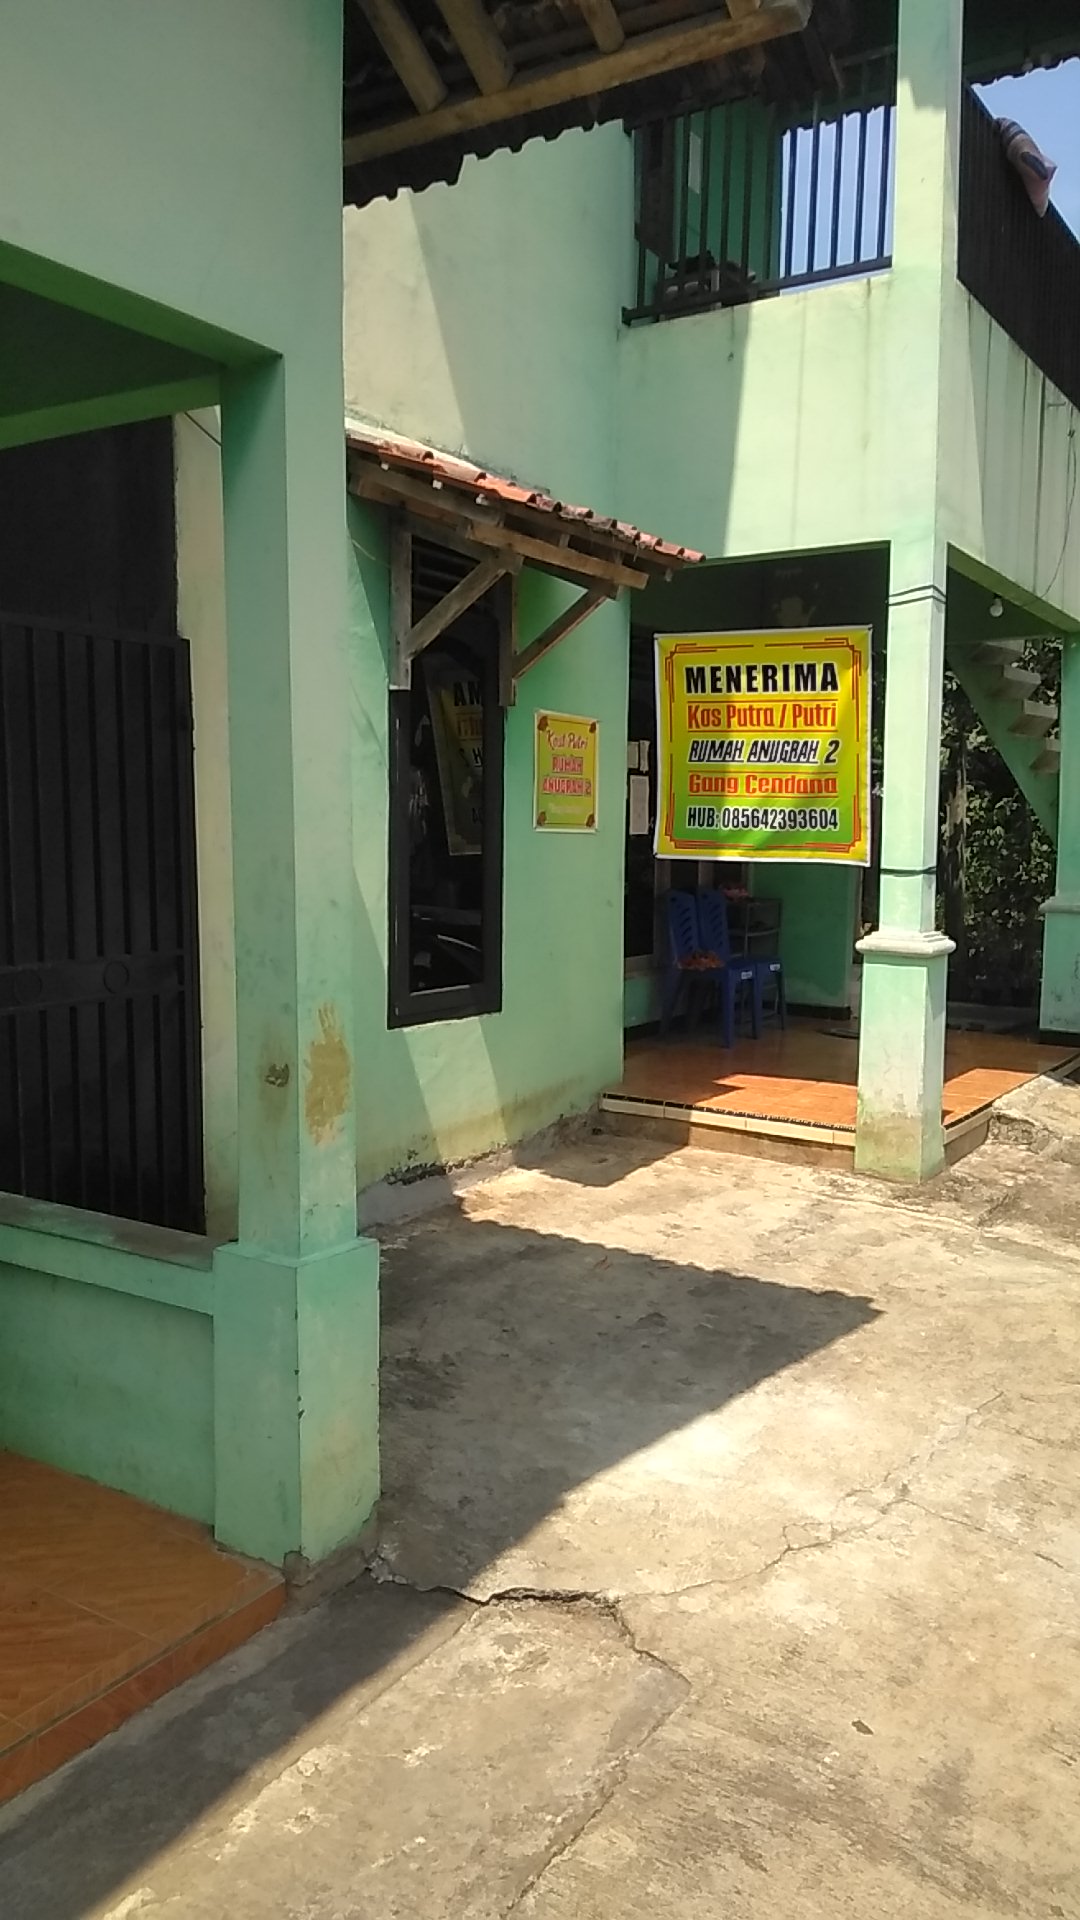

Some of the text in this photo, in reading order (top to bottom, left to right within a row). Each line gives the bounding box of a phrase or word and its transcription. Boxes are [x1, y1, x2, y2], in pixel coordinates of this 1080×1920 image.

[685, 663, 839, 694] MENERIMA
[687, 703, 837, 729] Kos Putra / Putri
[688, 740, 840, 763] RUMAH ANUGRAH 2
[552, 757, 583, 774] RUMAH
[543, 777, 583, 795] ANUGRAH
[689, 774, 838, 794] Gang Cendana
